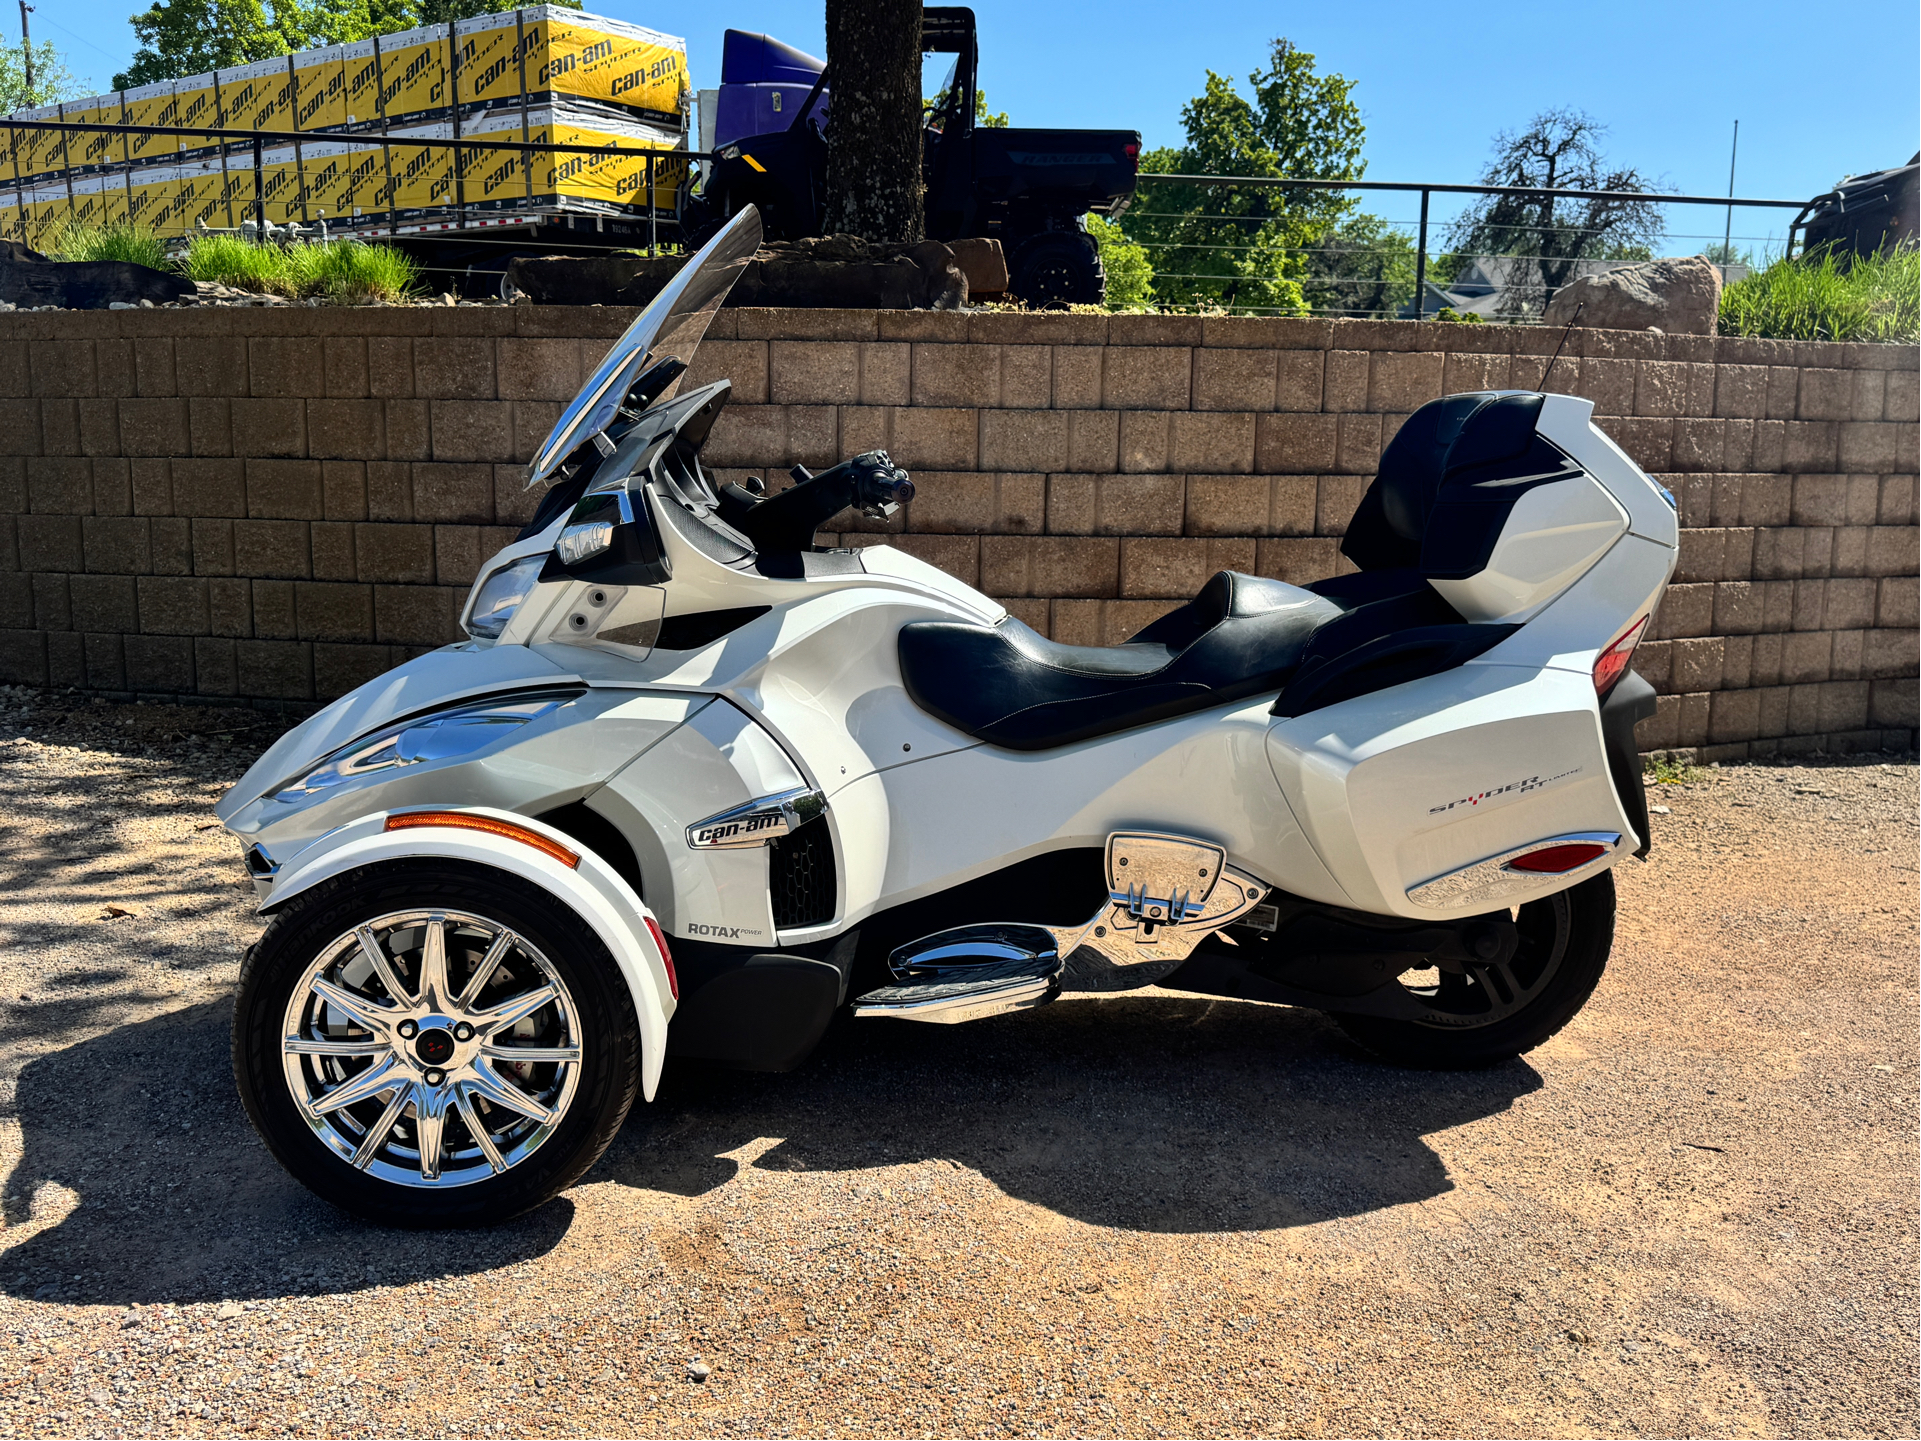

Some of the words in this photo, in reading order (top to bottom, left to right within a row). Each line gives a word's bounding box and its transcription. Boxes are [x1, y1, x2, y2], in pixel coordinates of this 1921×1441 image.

[406, 58, 441, 92] SPYD
[455, 34, 503, 79] PYDER
[474, 27, 539, 96] can-am
[539, 39, 613, 87] can-am
[583, 47, 641, 75] SPYDER
[611, 55, 676, 97] can-am
[279, 70, 322, 114] SPDER
[353, 55, 399, 103] SPYER
[375, 47, 430, 114] can-am
[353, 152, 399, 195] SPYDR
[375, 147, 430, 207] can-am
[407, 149, 447, 189] SPYDE
[431, 146, 484, 202] canam
[547, 140, 617, 188] can-am
[616, 157, 681, 196] canam
[1021, 154, 1102, 164] RANGER
[316, 167, 350, 199] SPYDE
[1429, 776, 1539, 816] SPYDER
[1520, 780, 1548, 793] RT
[698, 815, 780, 842] can-am
[688, 922, 740, 939] ROTAX
[740, 928, 762, 936] POWER
